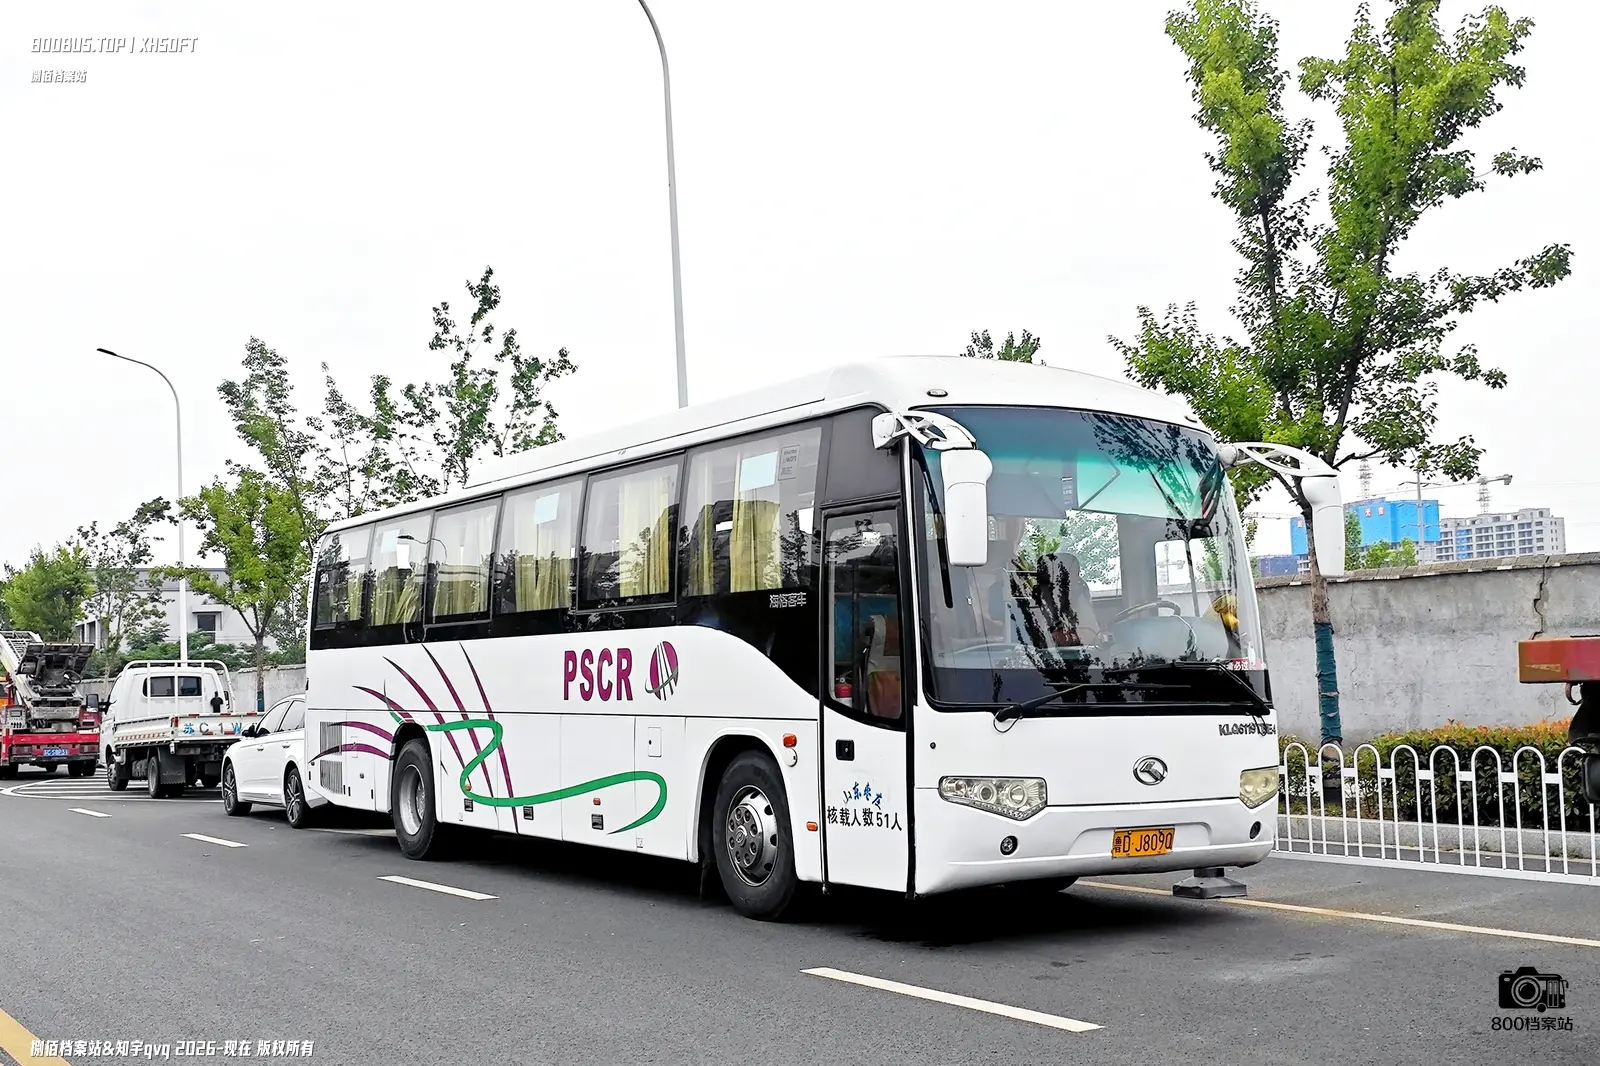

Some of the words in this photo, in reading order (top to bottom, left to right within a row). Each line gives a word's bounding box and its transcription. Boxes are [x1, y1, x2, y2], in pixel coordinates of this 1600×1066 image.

[563, 647, 634, 702] PSCR
[826, 805, 903, 832] 核载人数51人
